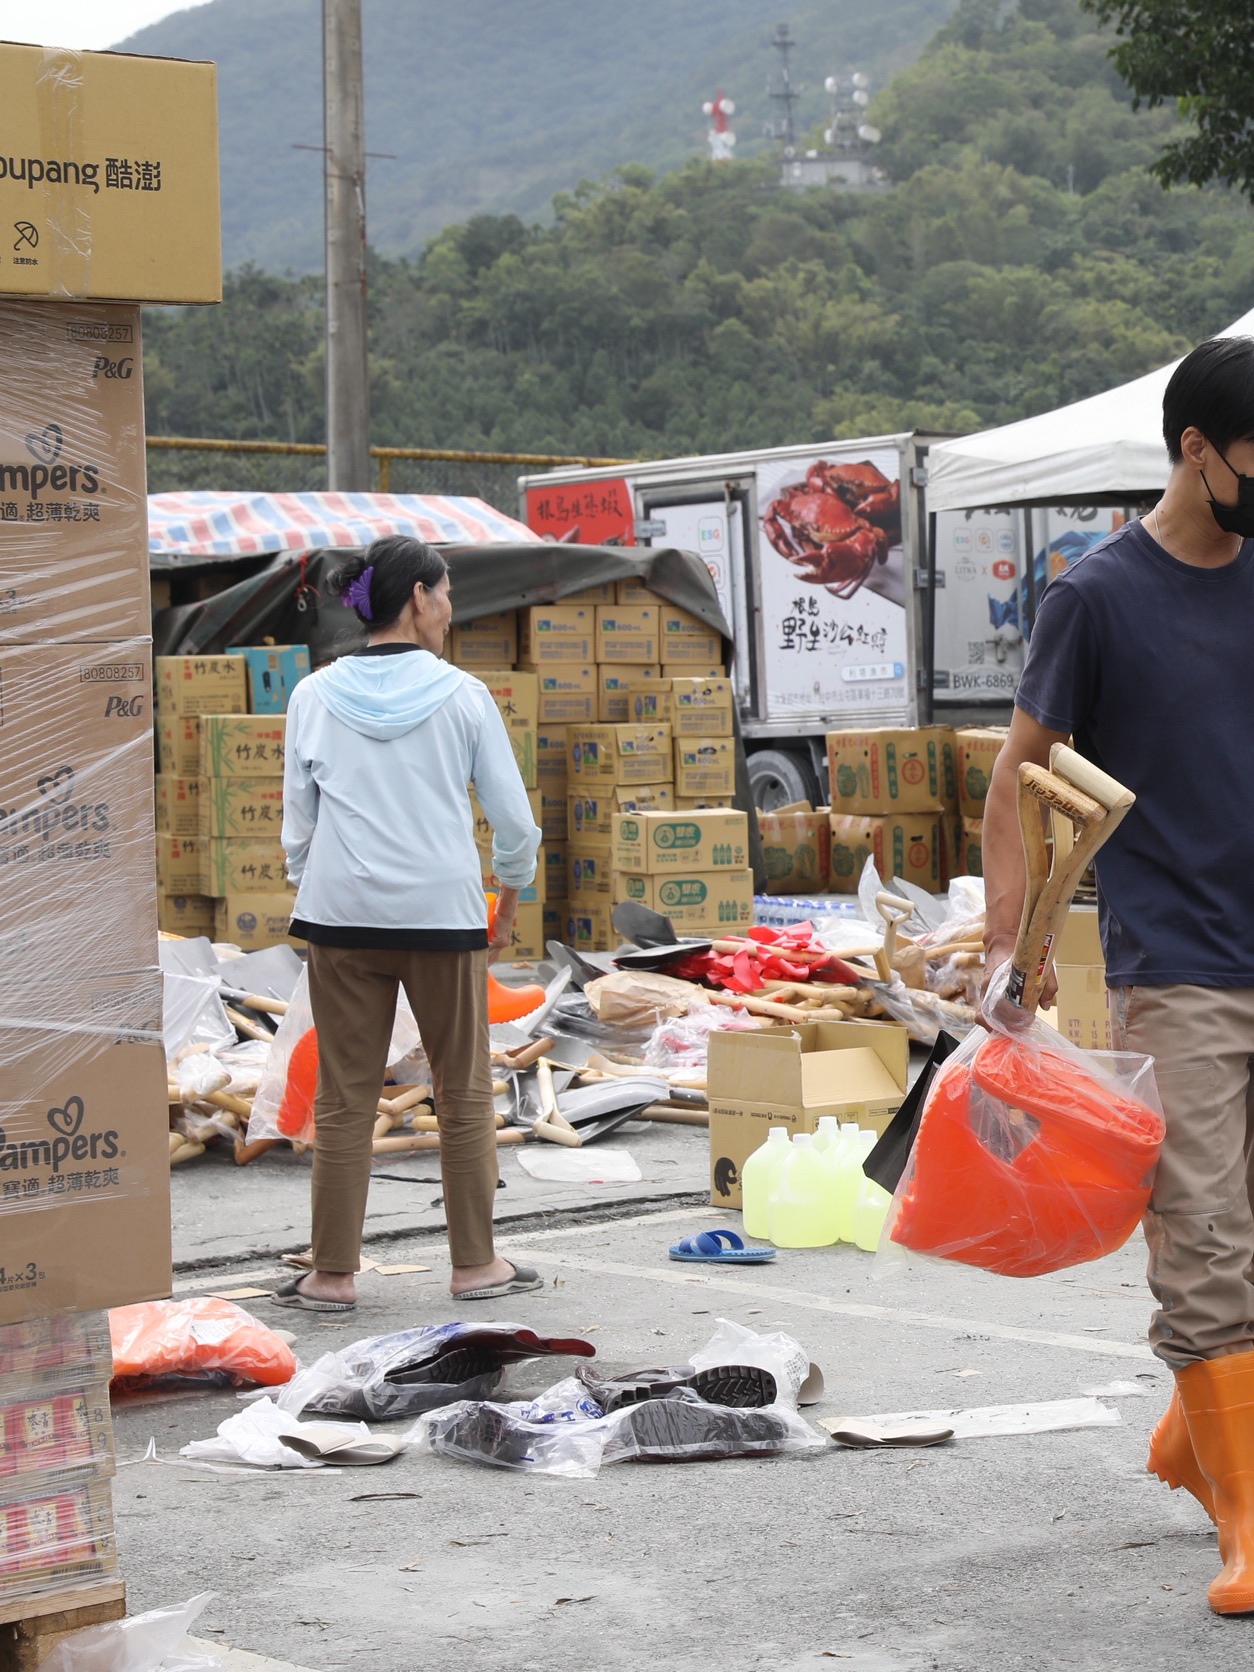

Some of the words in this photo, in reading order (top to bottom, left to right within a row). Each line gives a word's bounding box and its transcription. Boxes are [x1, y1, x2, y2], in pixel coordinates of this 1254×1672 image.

[105, 157, 162, 192] 酷澎
[92, 356, 134, 379] P&G
[701, 529, 720, 541] ESG
[83, 666, 141, 680] 80808257
[195, 660, 236, 675] 竹炭水
[953, 674, 1014, 689] BWK-6869
[104, 694, 145, 718] P&G
